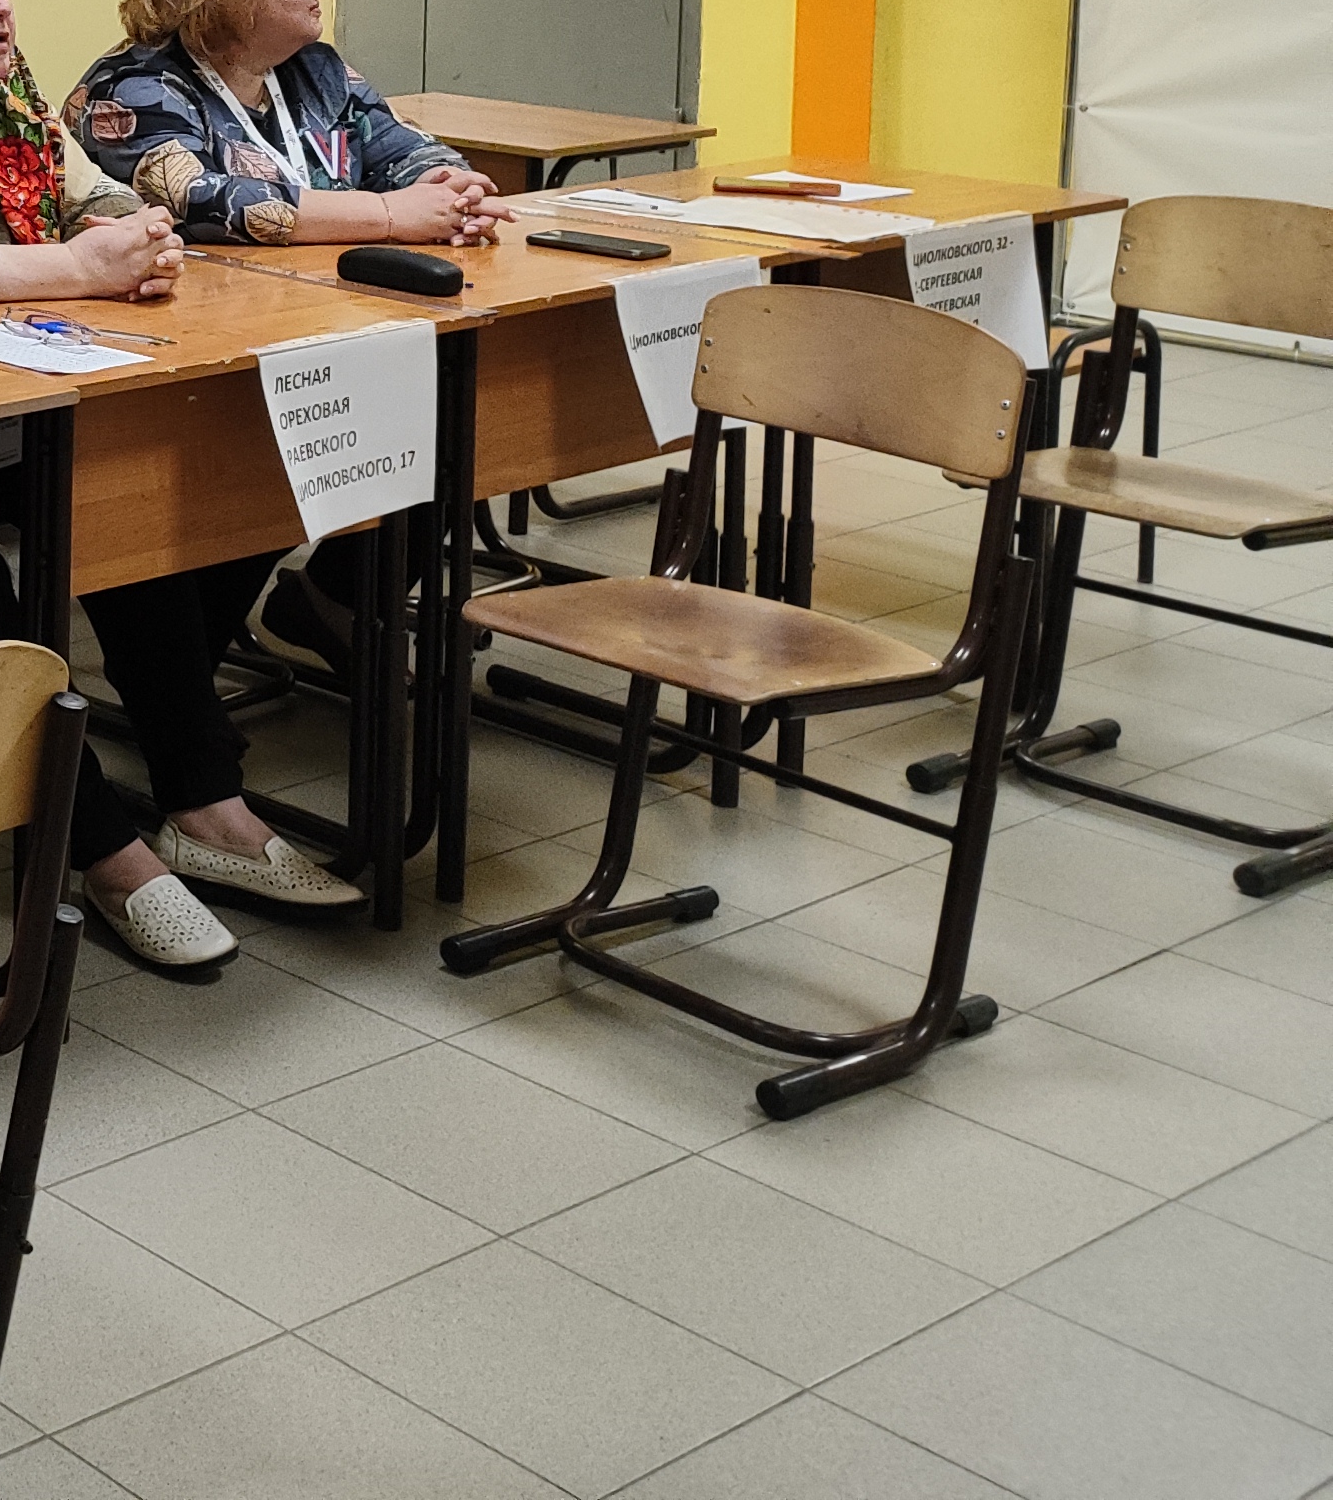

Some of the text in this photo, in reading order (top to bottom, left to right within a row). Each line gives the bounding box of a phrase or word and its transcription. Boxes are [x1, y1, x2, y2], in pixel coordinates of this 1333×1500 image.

[913, 238, 995, 267] ЦИОЛКОВСКОГО,
[996, 236, 1008, 251] 32
[629, 322, 703, 353] Циолковског
[274, 366, 331, 395] ЛЕСНАЯ
[279, 396, 351, 430] ОРЕХОВАЯ
[286, 430, 358, 467] РАЕВСКОГО
[296, 450, 416, 505] ЦИОЛКОВСКОГО, 17
